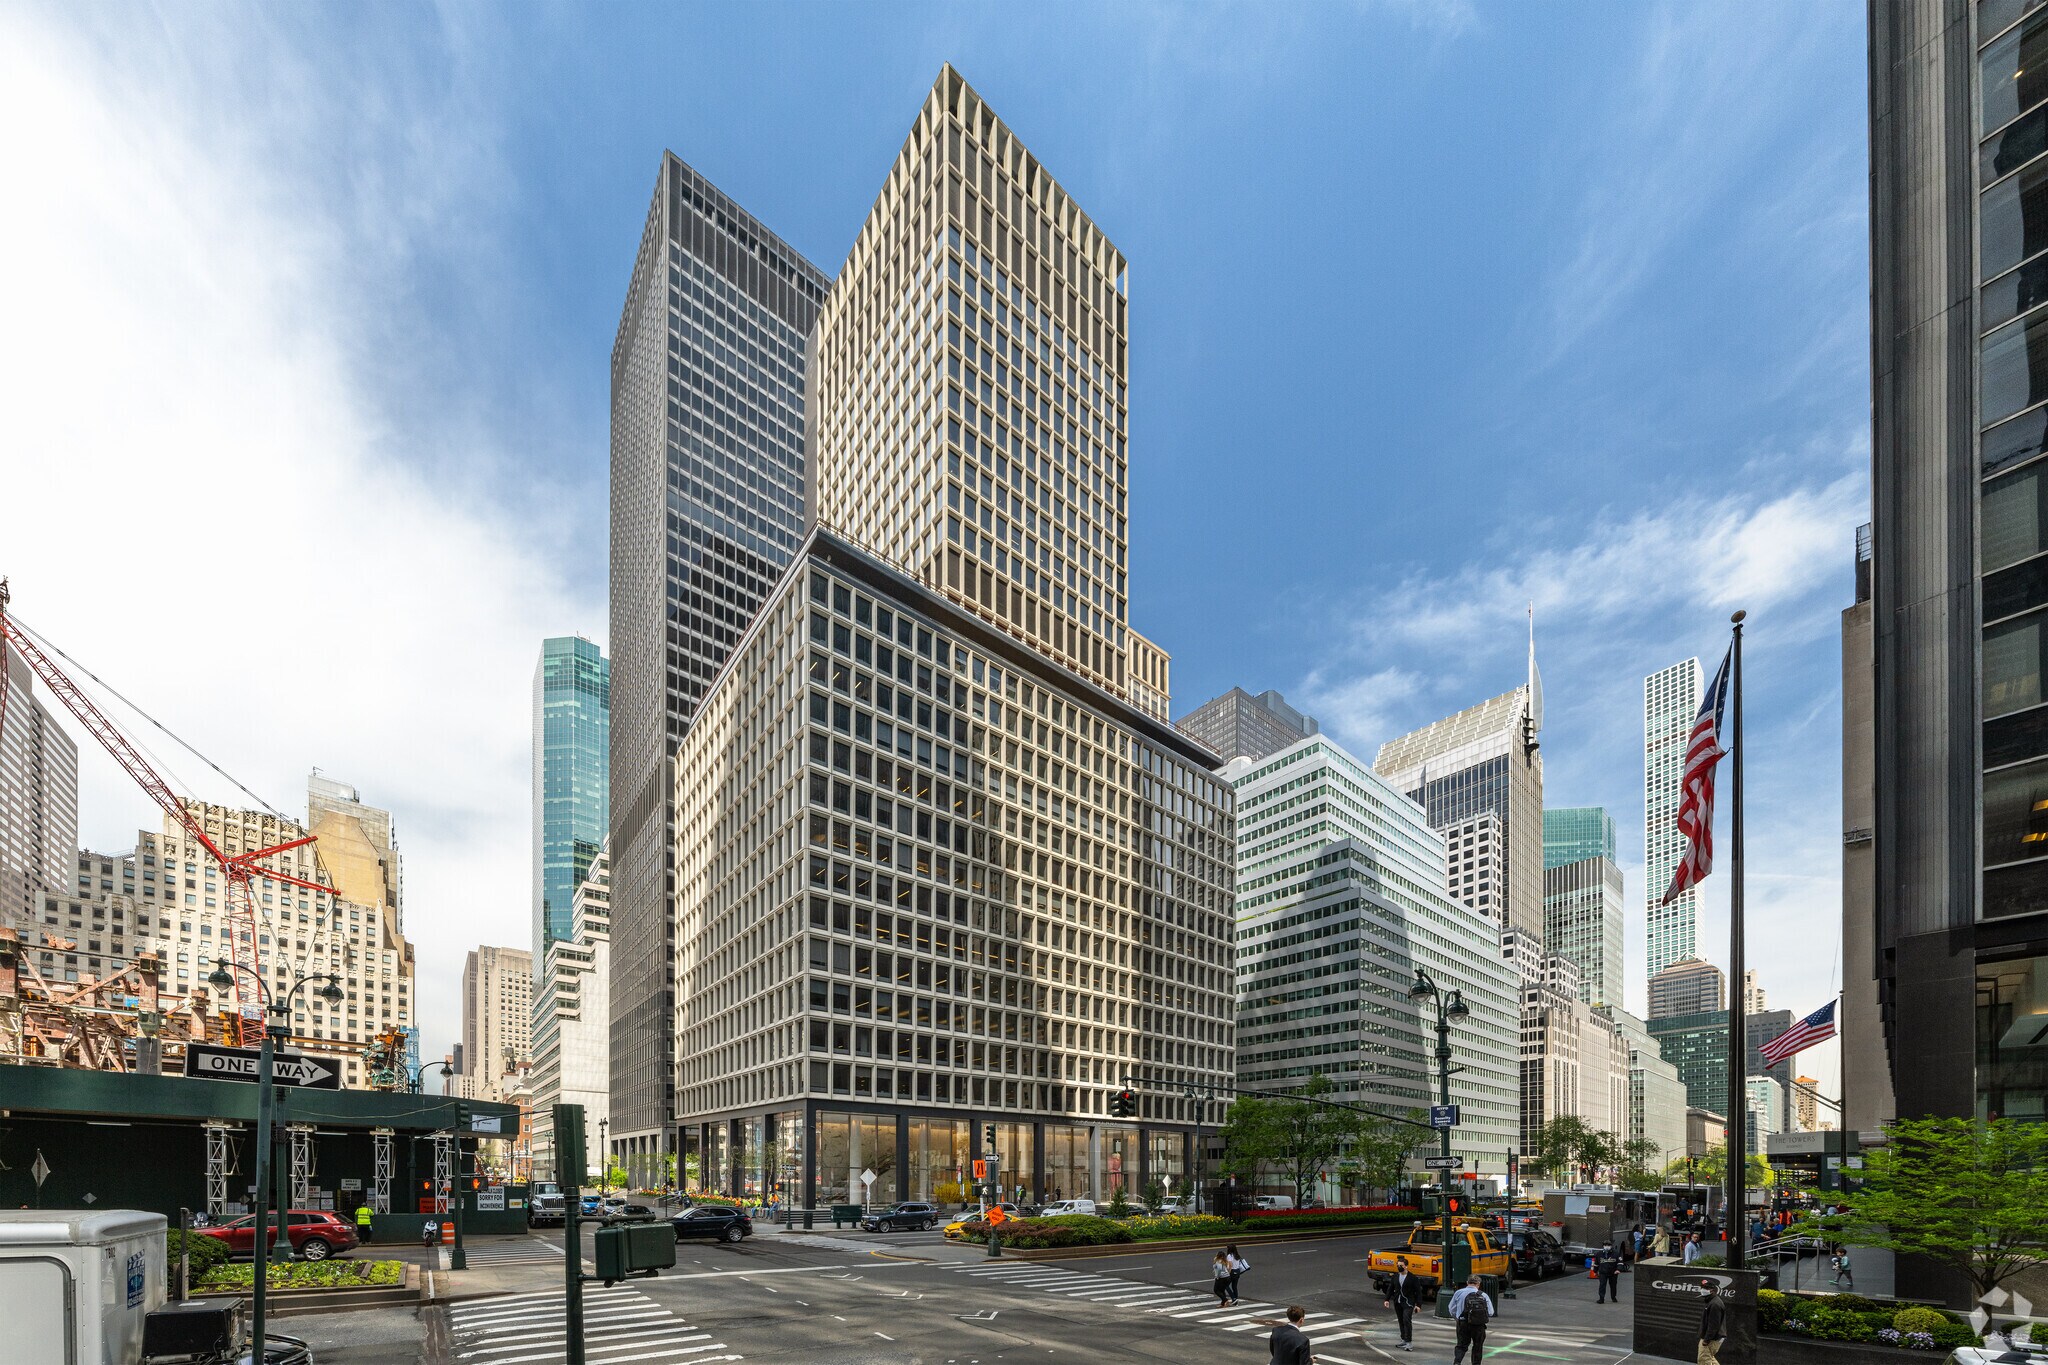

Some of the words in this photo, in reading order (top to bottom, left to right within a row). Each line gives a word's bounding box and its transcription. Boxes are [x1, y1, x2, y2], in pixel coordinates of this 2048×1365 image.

[211, 1057, 255, 1073] ONE
[277, 1063, 318, 1078] WAY
[1652, 1280, 1702, 1292] Capita
